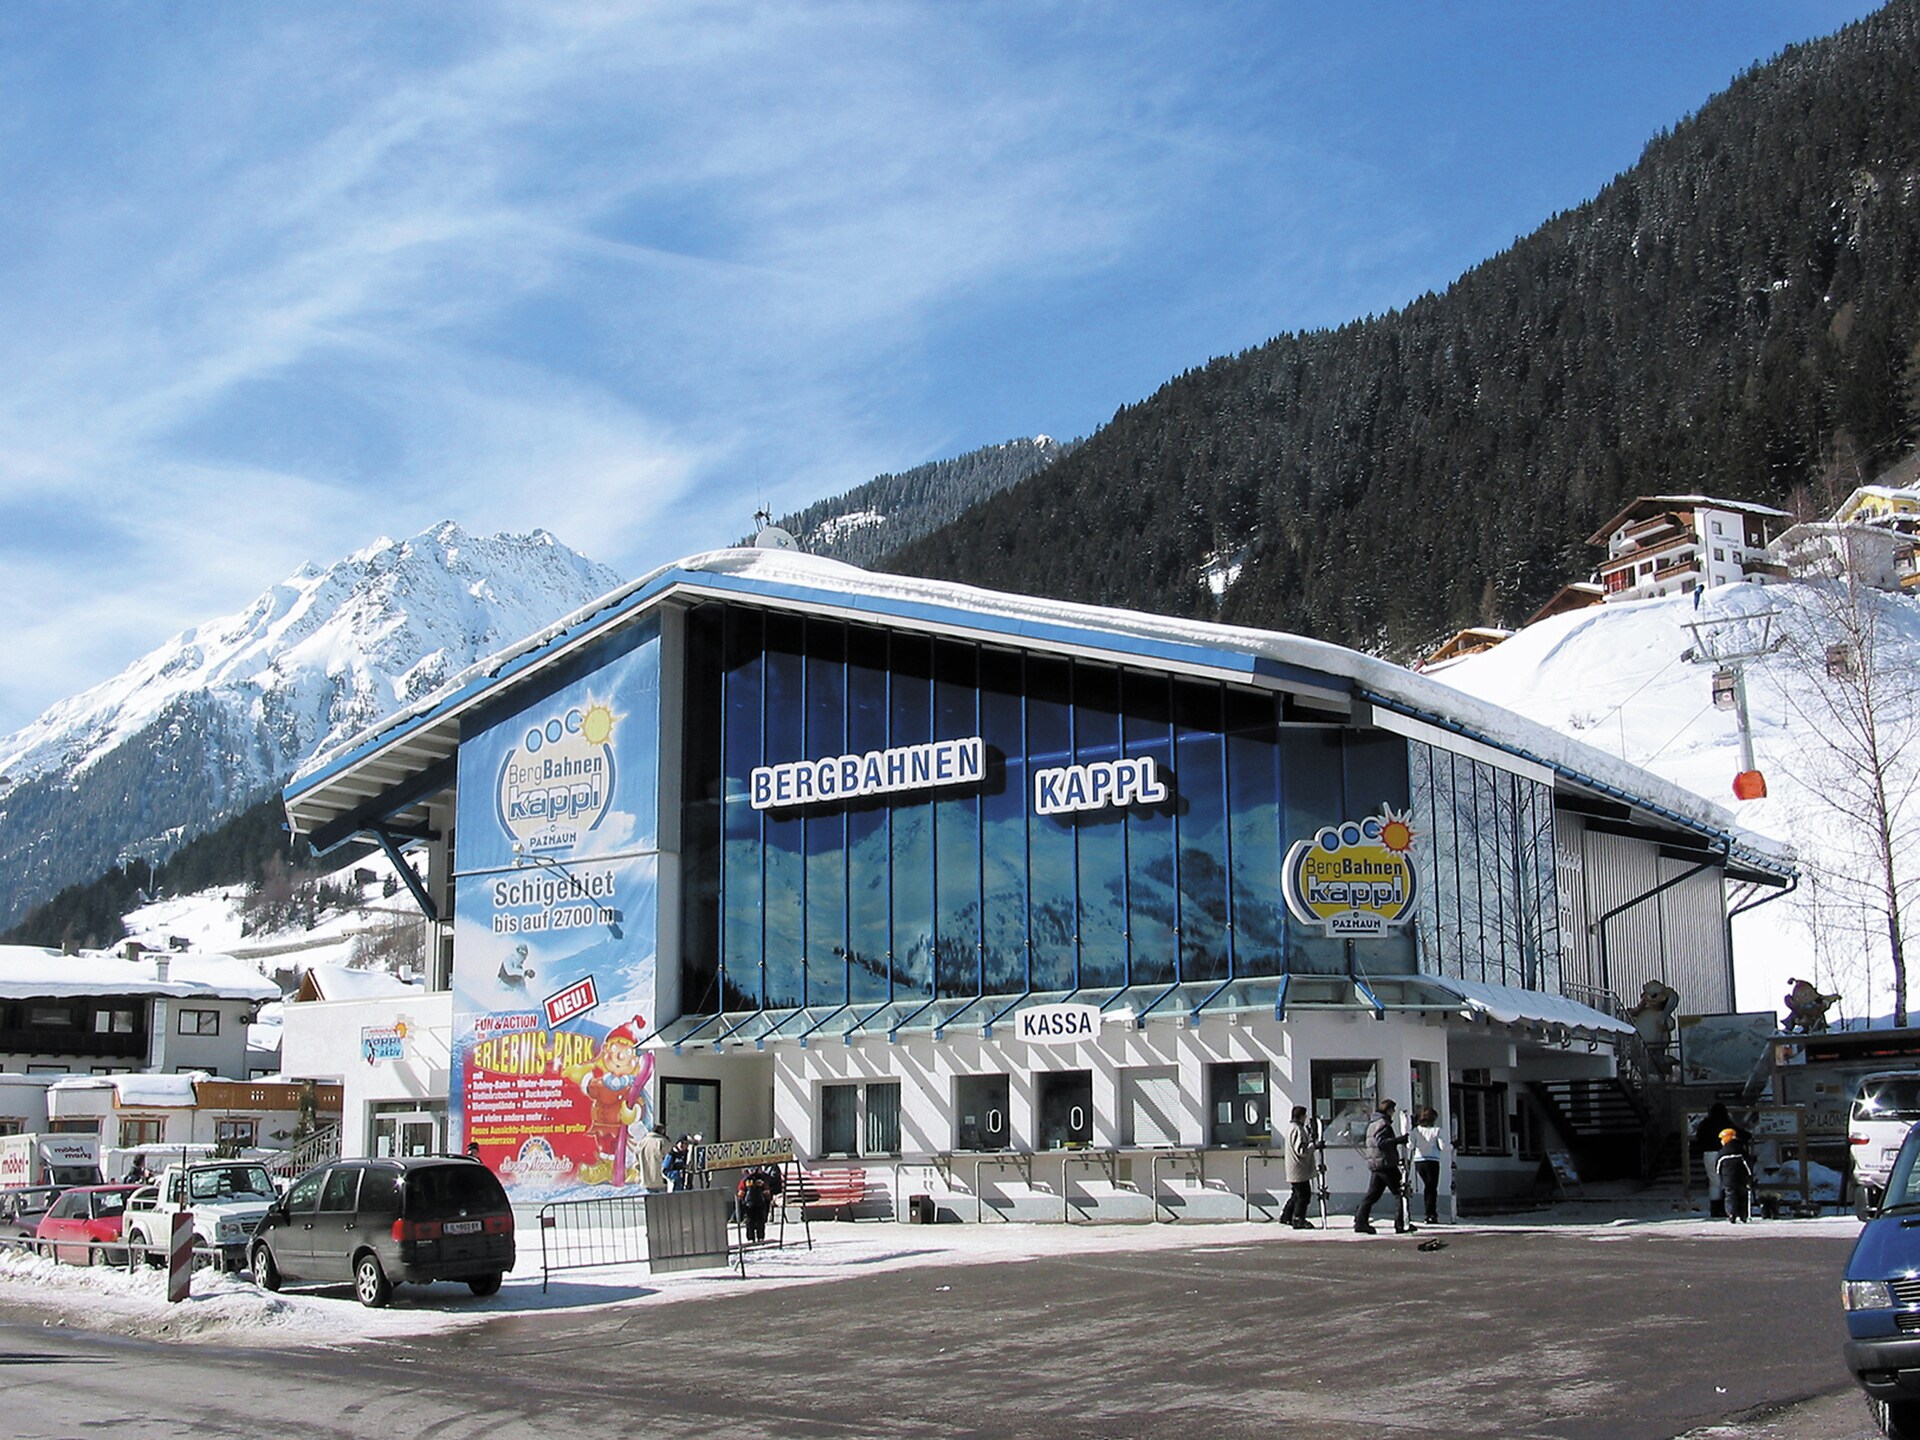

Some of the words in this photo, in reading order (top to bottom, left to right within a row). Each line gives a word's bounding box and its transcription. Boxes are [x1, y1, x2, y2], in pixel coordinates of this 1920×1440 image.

[508, 755, 603, 786] BergBahnen
[752, 741, 982, 806] BERGBAHNEN
[1039, 760, 1166, 811] KAPPL
[508, 773, 603, 822] kappl
[530, 832, 577, 848] PAZNAUN
[1305, 857, 1403, 878] BergBahnen
[494, 869, 615, 907] Schigebiet
[1307, 875, 1404, 909] kappl
[494, 914, 518, 934] bis
[523, 911, 549, 931] auf
[554, 907, 593, 928] 2700
[599, 908, 614, 923] m
[1332, 919, 1381, 928] PAZNAUN
[552, 985, 589, 1019] NEU!
[475, 1018, 493, 1031] FUN
[494, 1017, 502, 1030] &
[503, 1015, 538, 1029] ACTION
[1023, 1011, 1093, 1037] KASSA
[707, 1143, 734, 1161] SPORT
[739, 1140, 760, 1157] SHOP
[762, 1137, 793, 1155] LADNER
